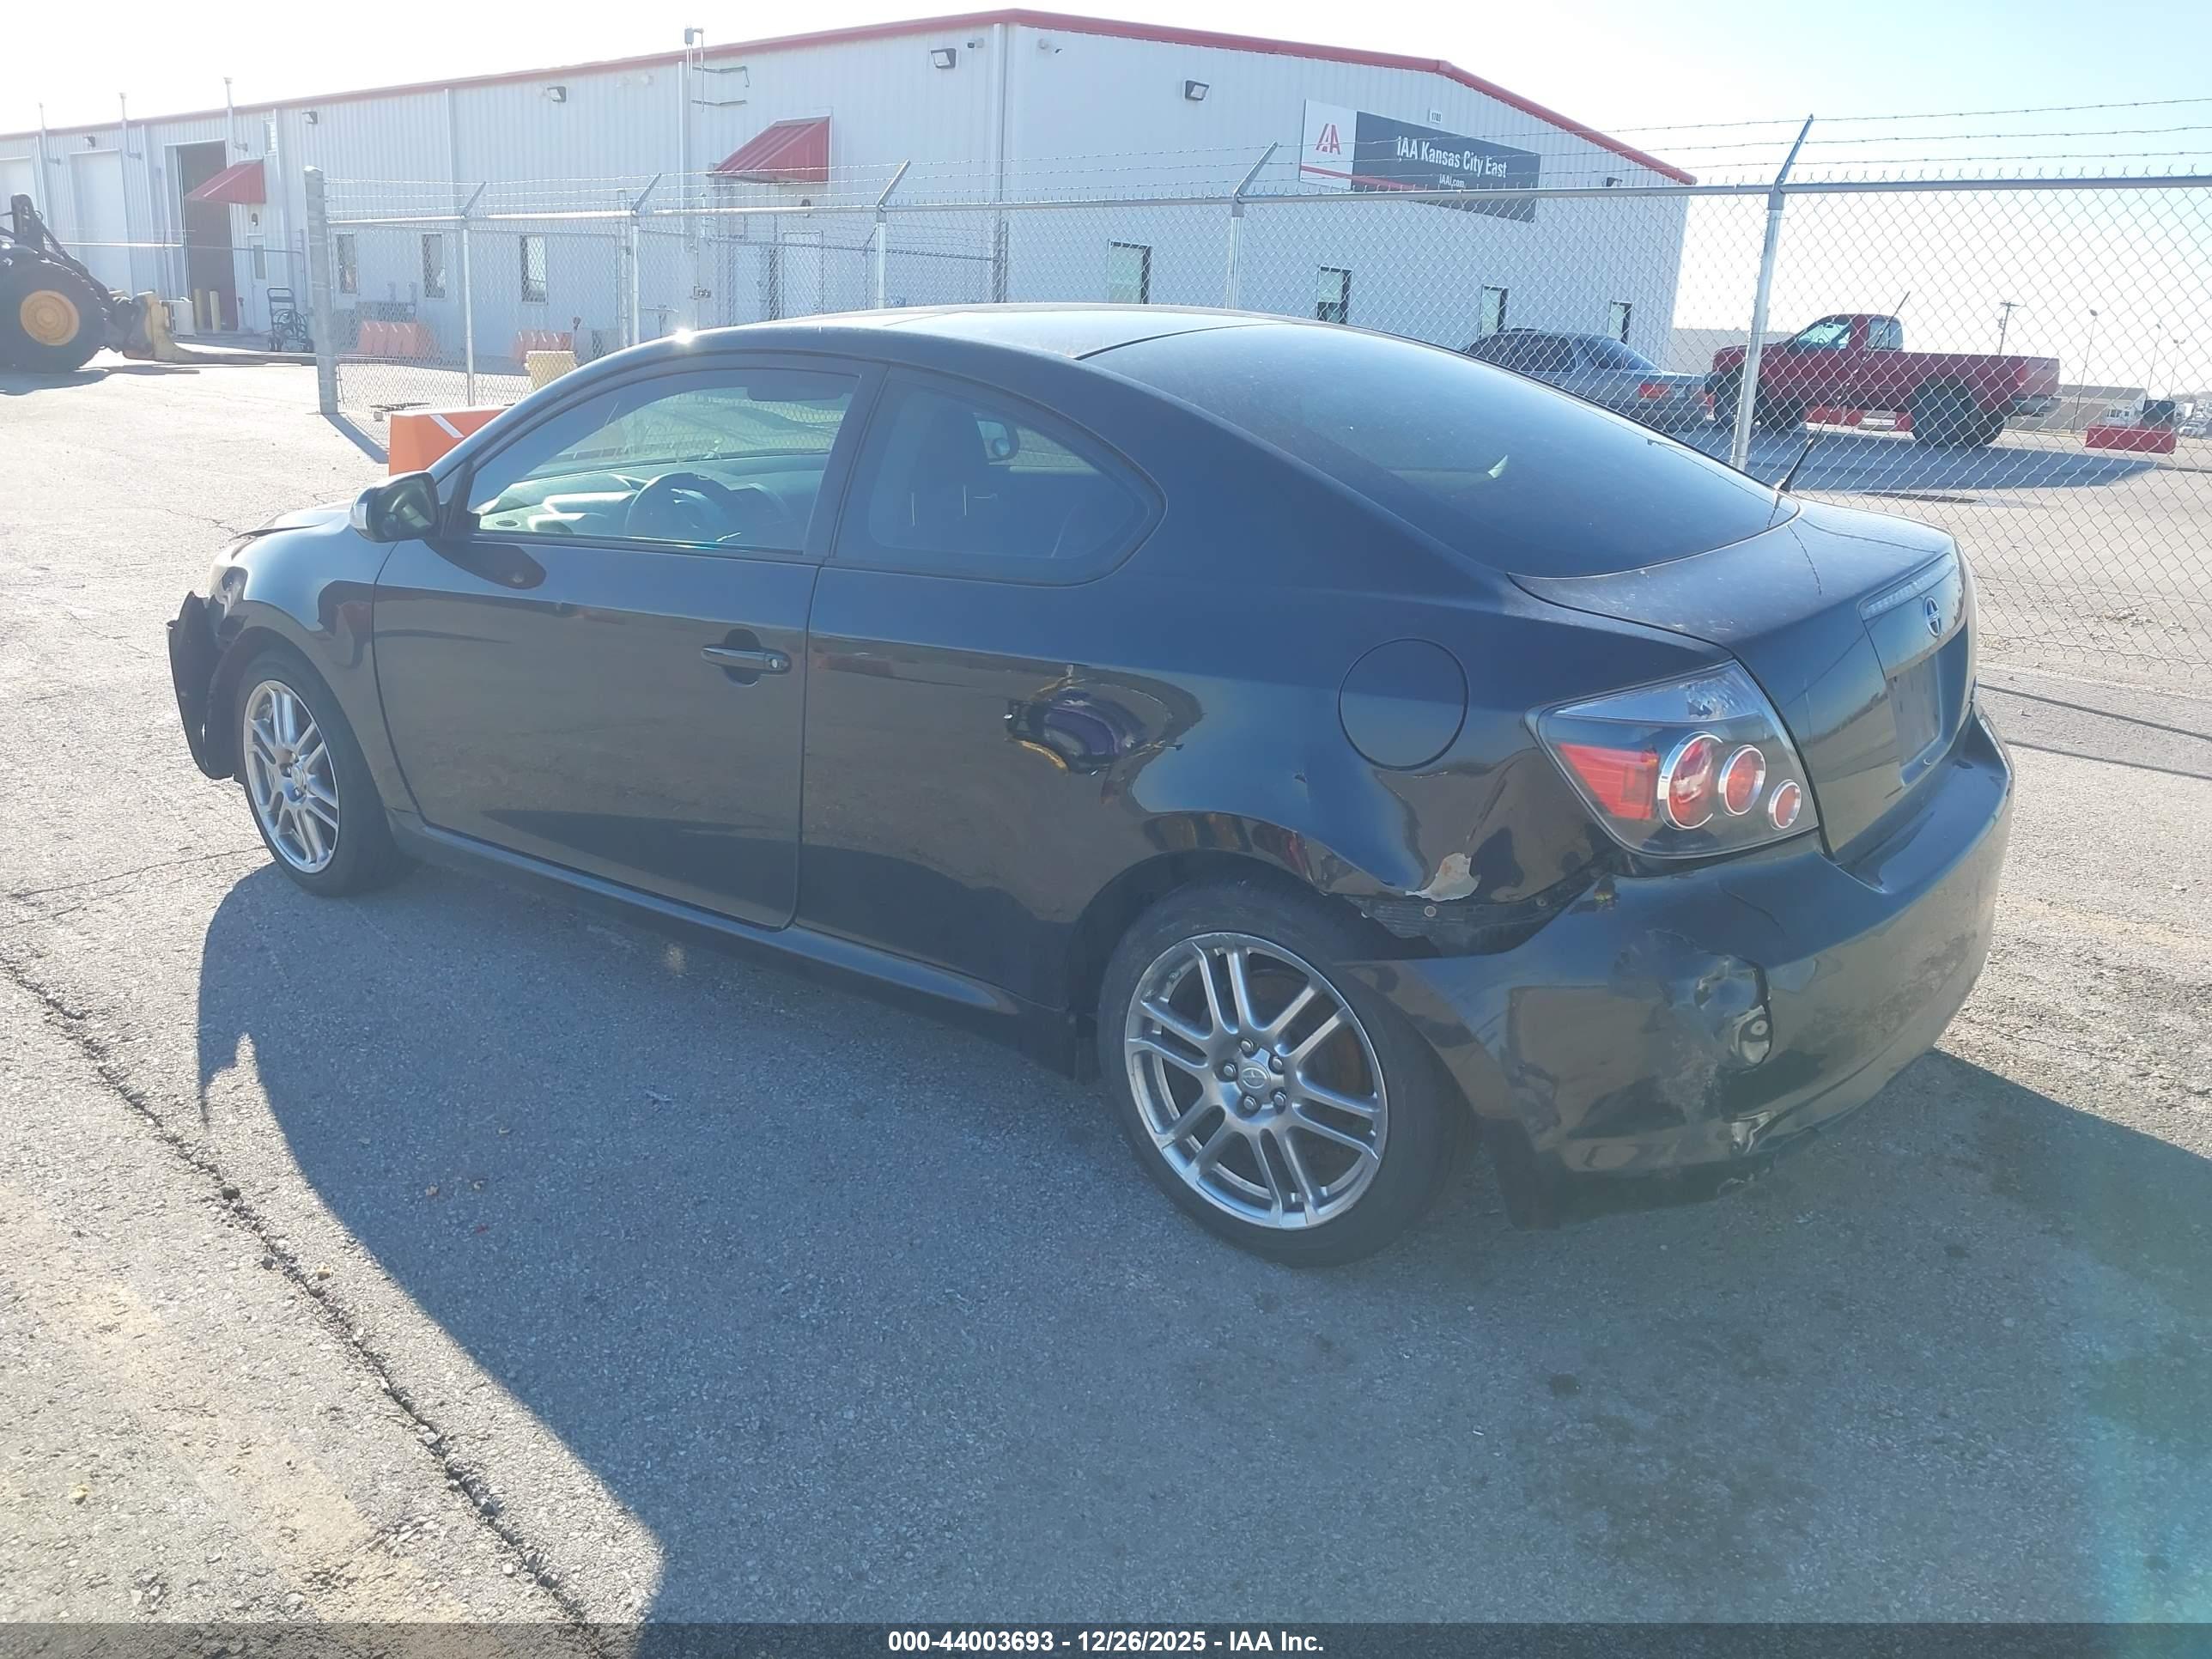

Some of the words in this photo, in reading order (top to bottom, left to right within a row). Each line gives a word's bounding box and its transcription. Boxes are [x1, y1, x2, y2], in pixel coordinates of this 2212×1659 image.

[1397, 136, 1419, 161] IAA
[1421, 141, 1461, 168] Kansas
[1462, 150, 1484, 177] City
[1486, 156, 1508, 179] East
